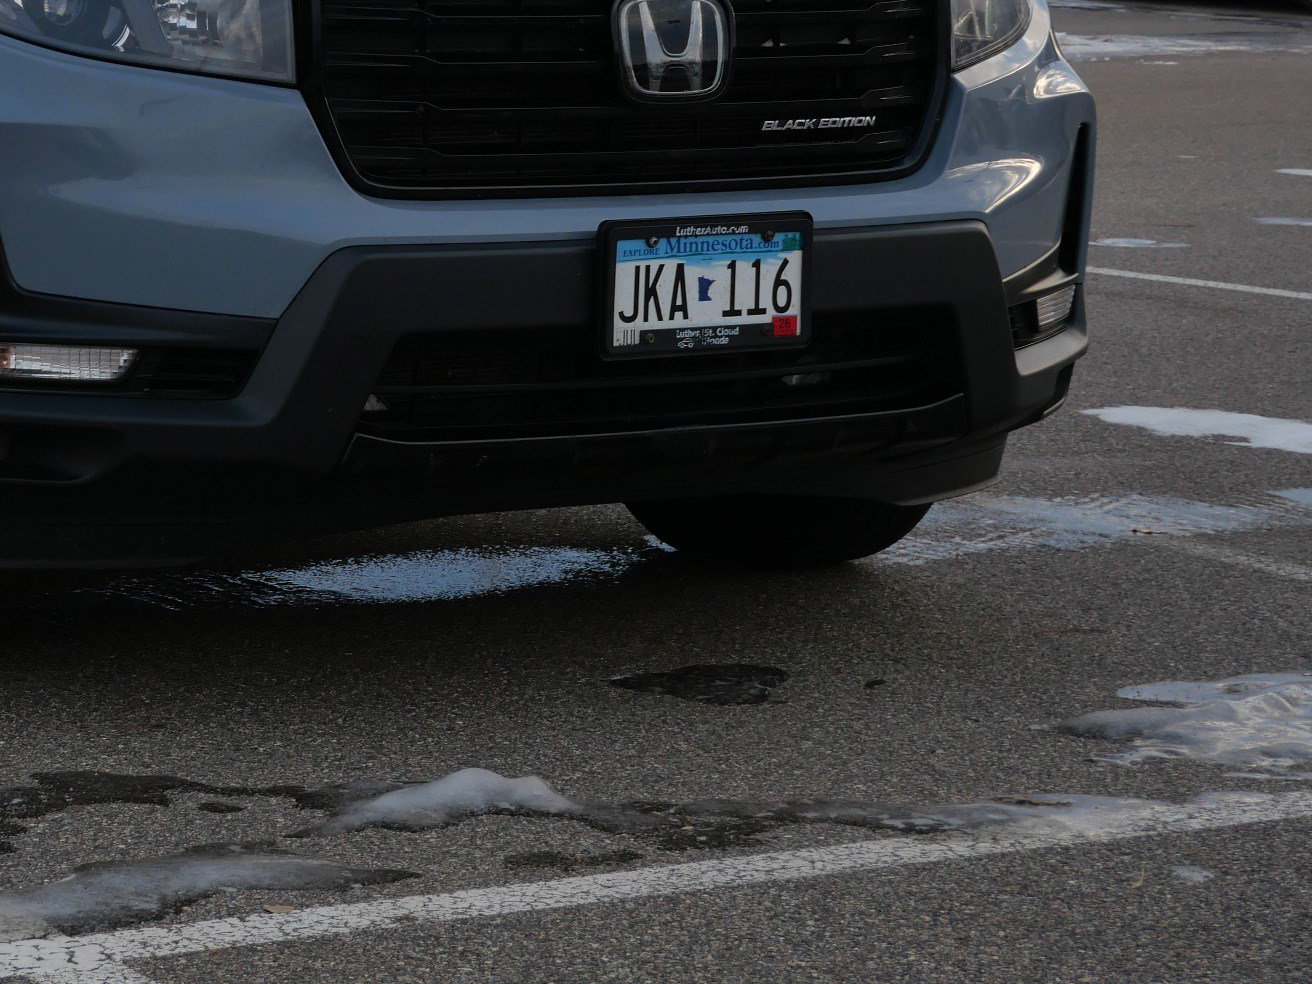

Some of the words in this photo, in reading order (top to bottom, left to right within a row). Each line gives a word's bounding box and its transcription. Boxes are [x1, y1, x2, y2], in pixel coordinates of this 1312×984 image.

[761, 119, 817, 131] BLACK
[817, 116, 876, 128] EDITION
[675, 225, 749, 236] LutherAuto.com
[622, 247, 660, 258] EXPLORE
[618, 262, 689, 323] JKA
[721, 257, 793, 317] 116
[716, 326, 740, 336] Cloud
